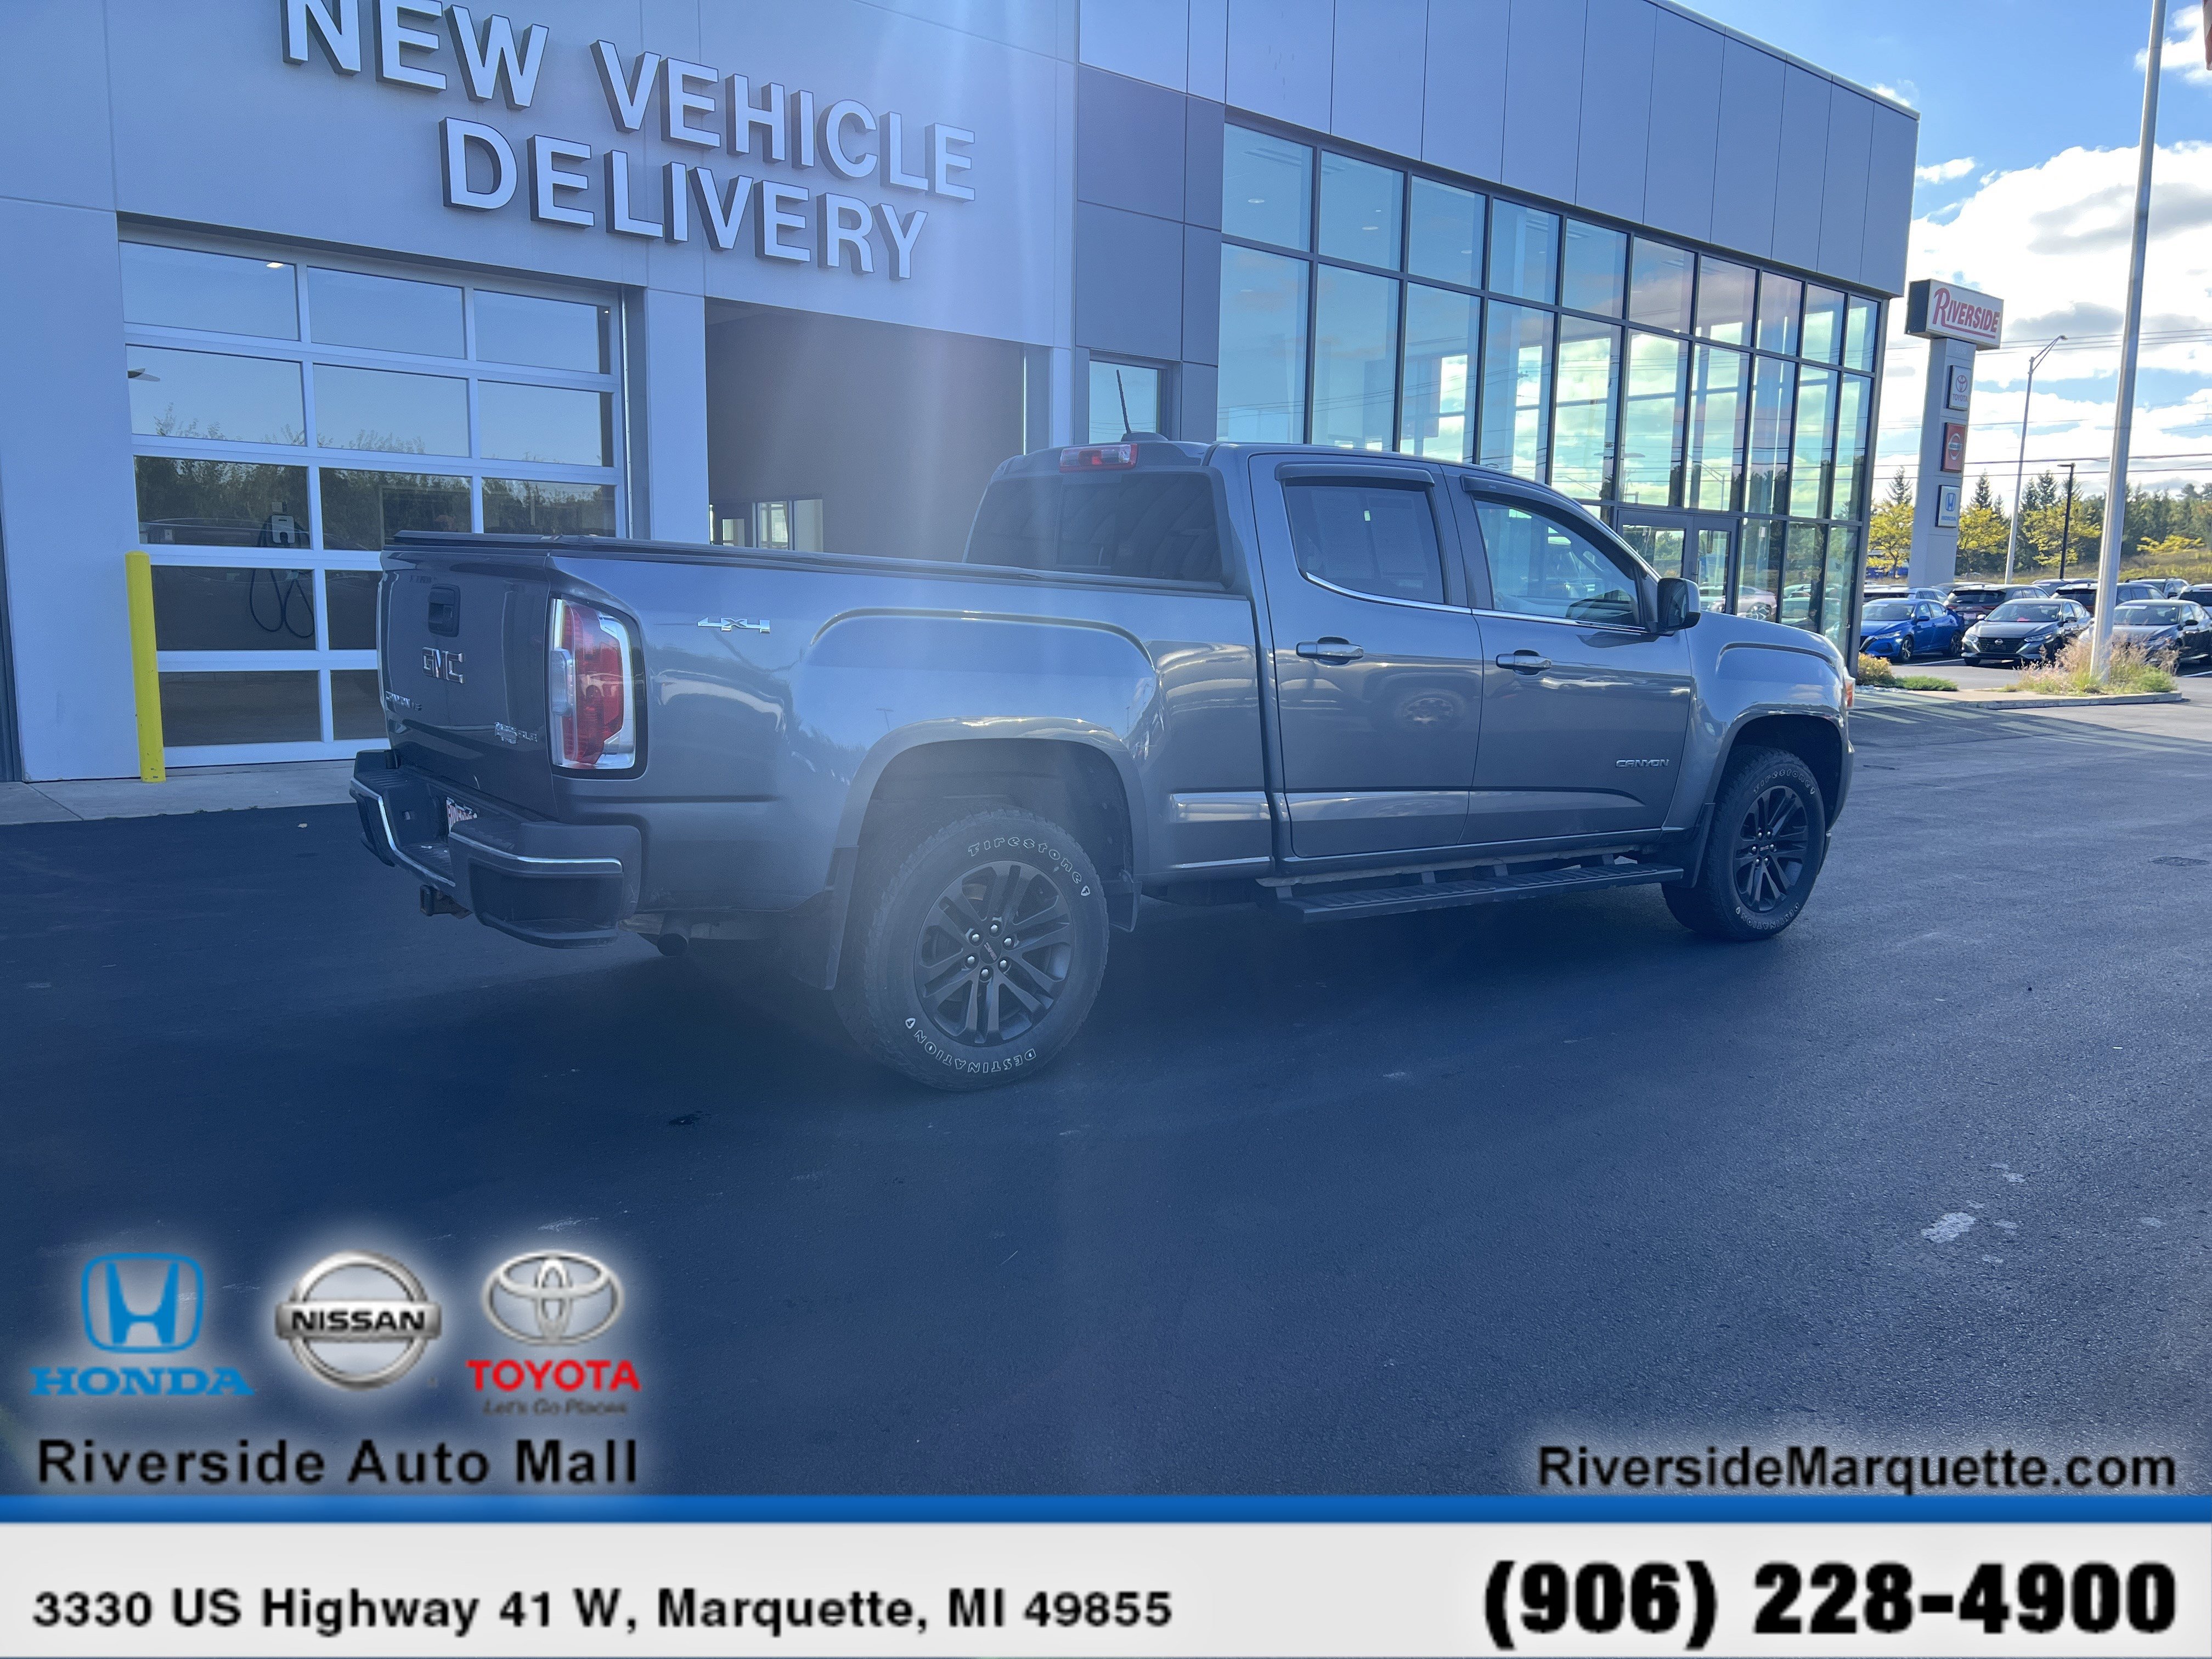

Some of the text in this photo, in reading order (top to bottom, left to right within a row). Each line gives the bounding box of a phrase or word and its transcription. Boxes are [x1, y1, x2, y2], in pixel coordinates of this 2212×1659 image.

[280, 0, 975, 202] NEW VEHICLE
[439, 117, 929, 280] DELIVERY
[1953, 393, 1968, 402] TOYOTA
[422, 647, 464, 684] GMC
[1616, 759, 1670, 768] CANYON
[914, 1029, 1037, 1073] DESTINATION
